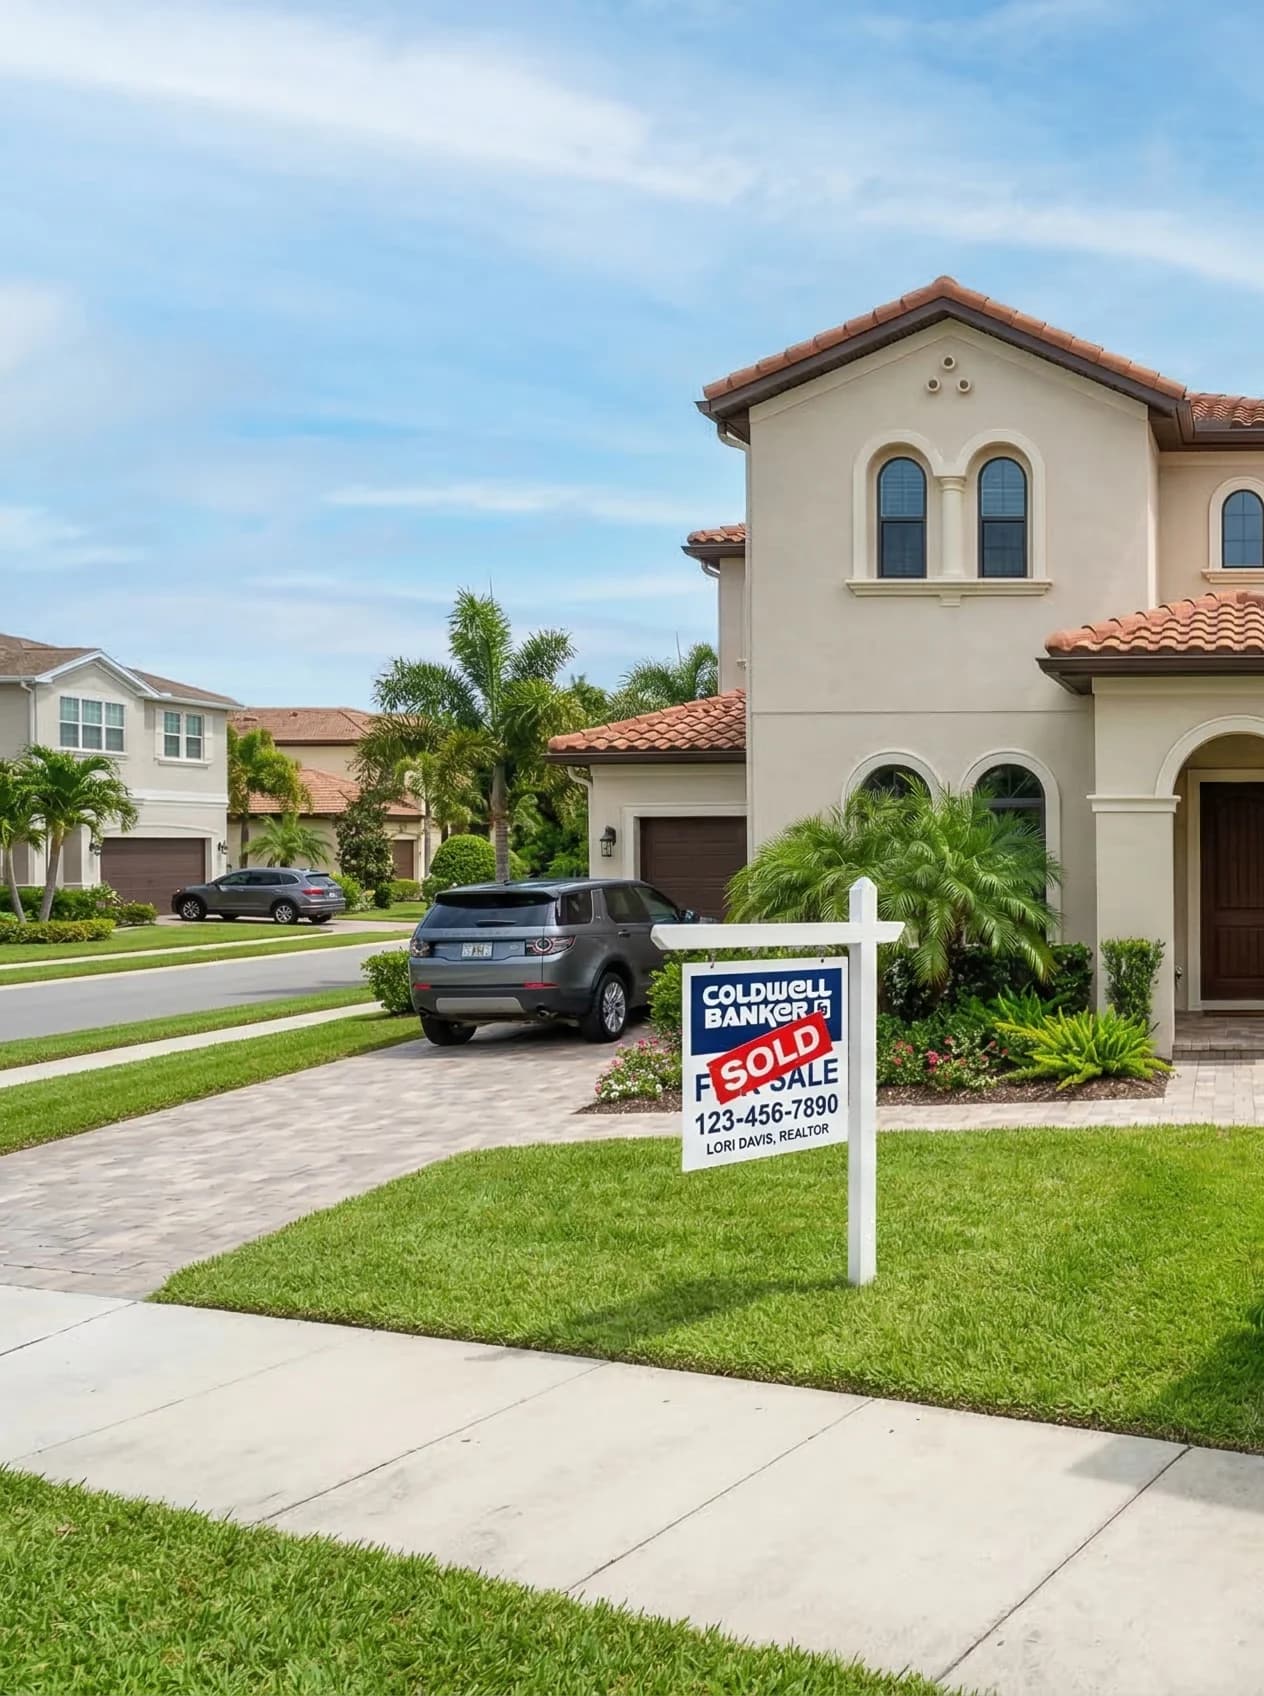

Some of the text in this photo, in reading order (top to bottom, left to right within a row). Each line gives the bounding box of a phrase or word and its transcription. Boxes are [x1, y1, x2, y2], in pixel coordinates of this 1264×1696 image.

[720, 1024, 820, 1092] SOLD
[695, 1093, 838, 1136] 123-456-7890
[706, 1123, 829, 1156] LORI DAVIS, REALTOR
